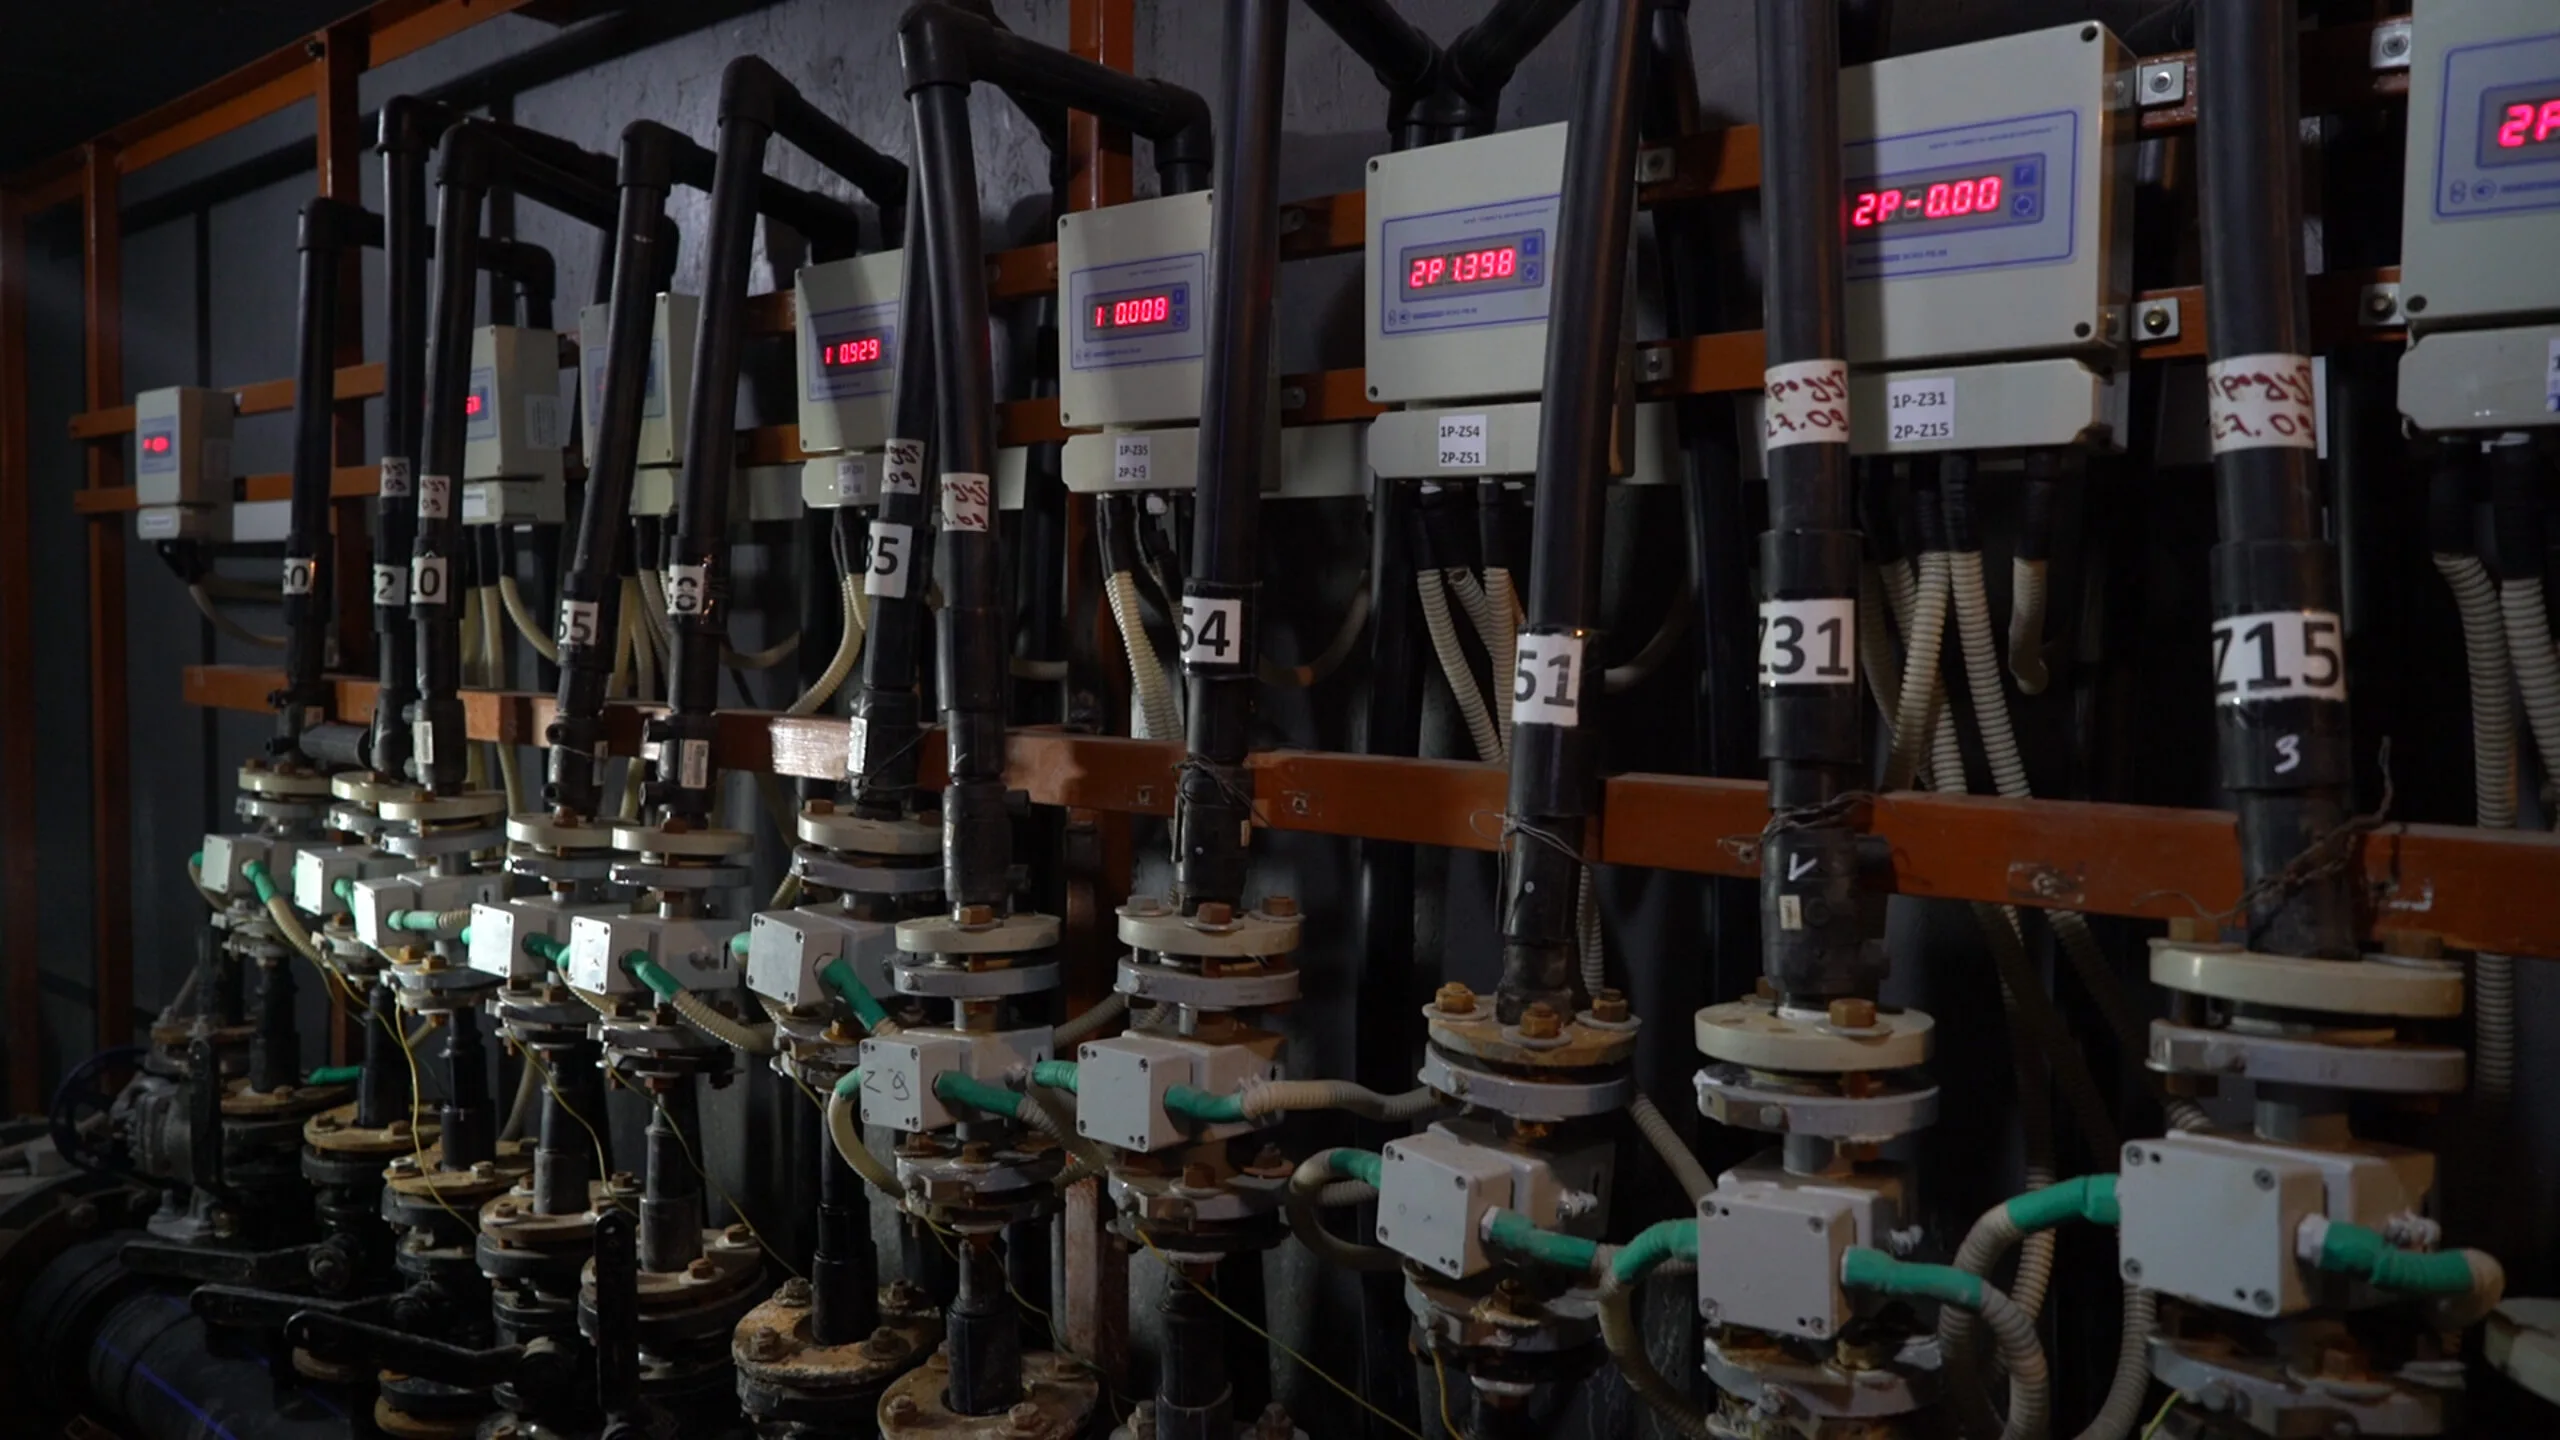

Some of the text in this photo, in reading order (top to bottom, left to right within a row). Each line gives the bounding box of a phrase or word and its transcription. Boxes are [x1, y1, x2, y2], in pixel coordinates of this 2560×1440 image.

[1893, 391, 1948, 409] 1P-Z31
[1441, 425, 1480, 438] 1P-Z54
[1894, 421, 1950, 439] 2P-Z15
[1441, 451, 1481, 464] 2P-Z51
[1515, 649, 1576, 708] 51
